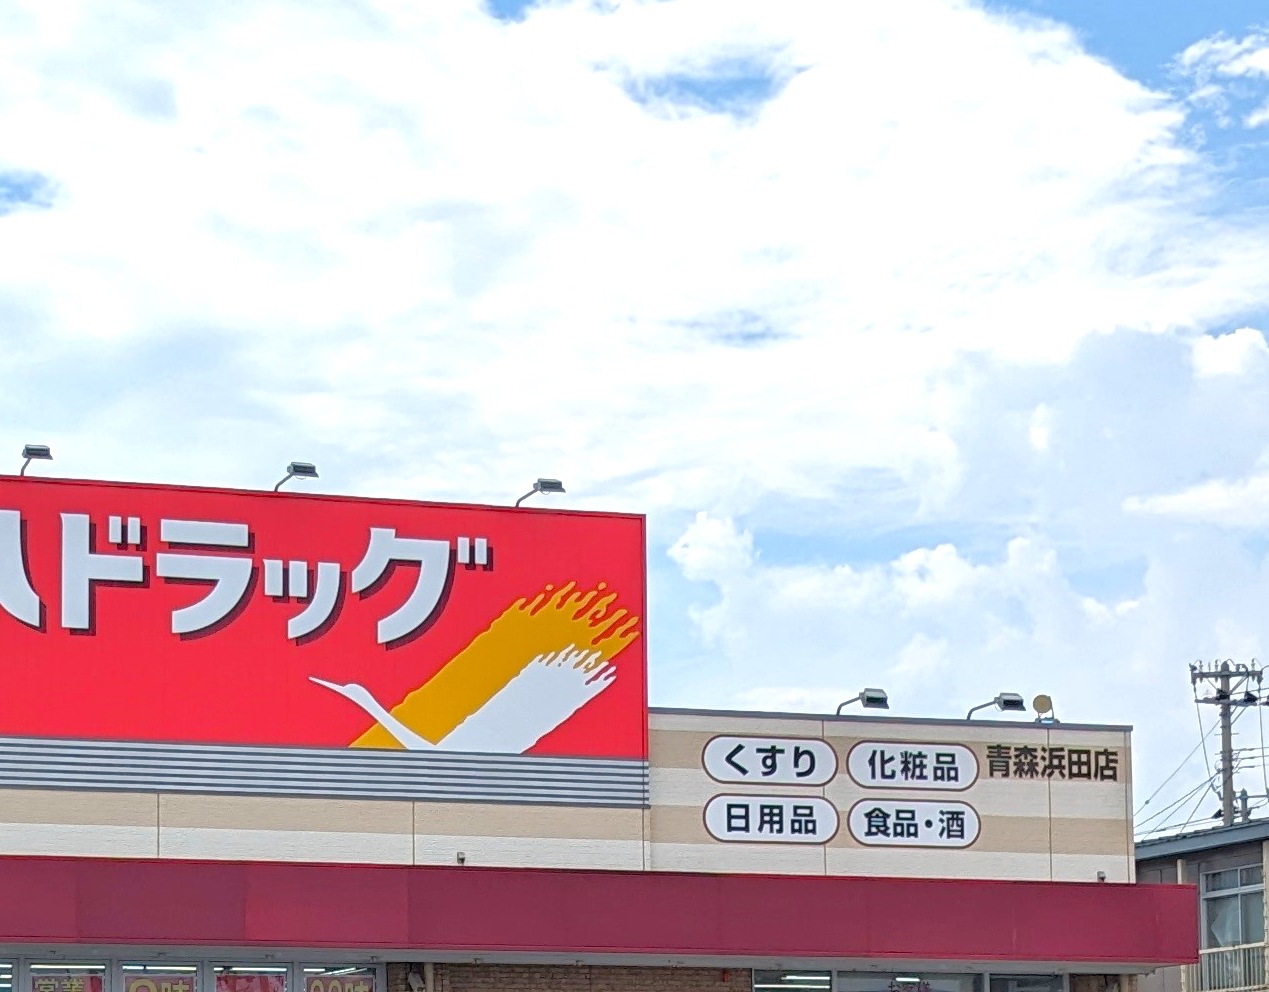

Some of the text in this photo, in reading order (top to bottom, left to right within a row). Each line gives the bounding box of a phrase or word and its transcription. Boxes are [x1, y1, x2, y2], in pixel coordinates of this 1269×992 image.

[724, 743, 816, 778] くすり
[867, 749, 960, 783] 化粧品
[985, 743, 1119, 782] 青森浜田店
[725, 803, 818, 835] 日用品
[863, 807, 966, 840] 食品・酒
